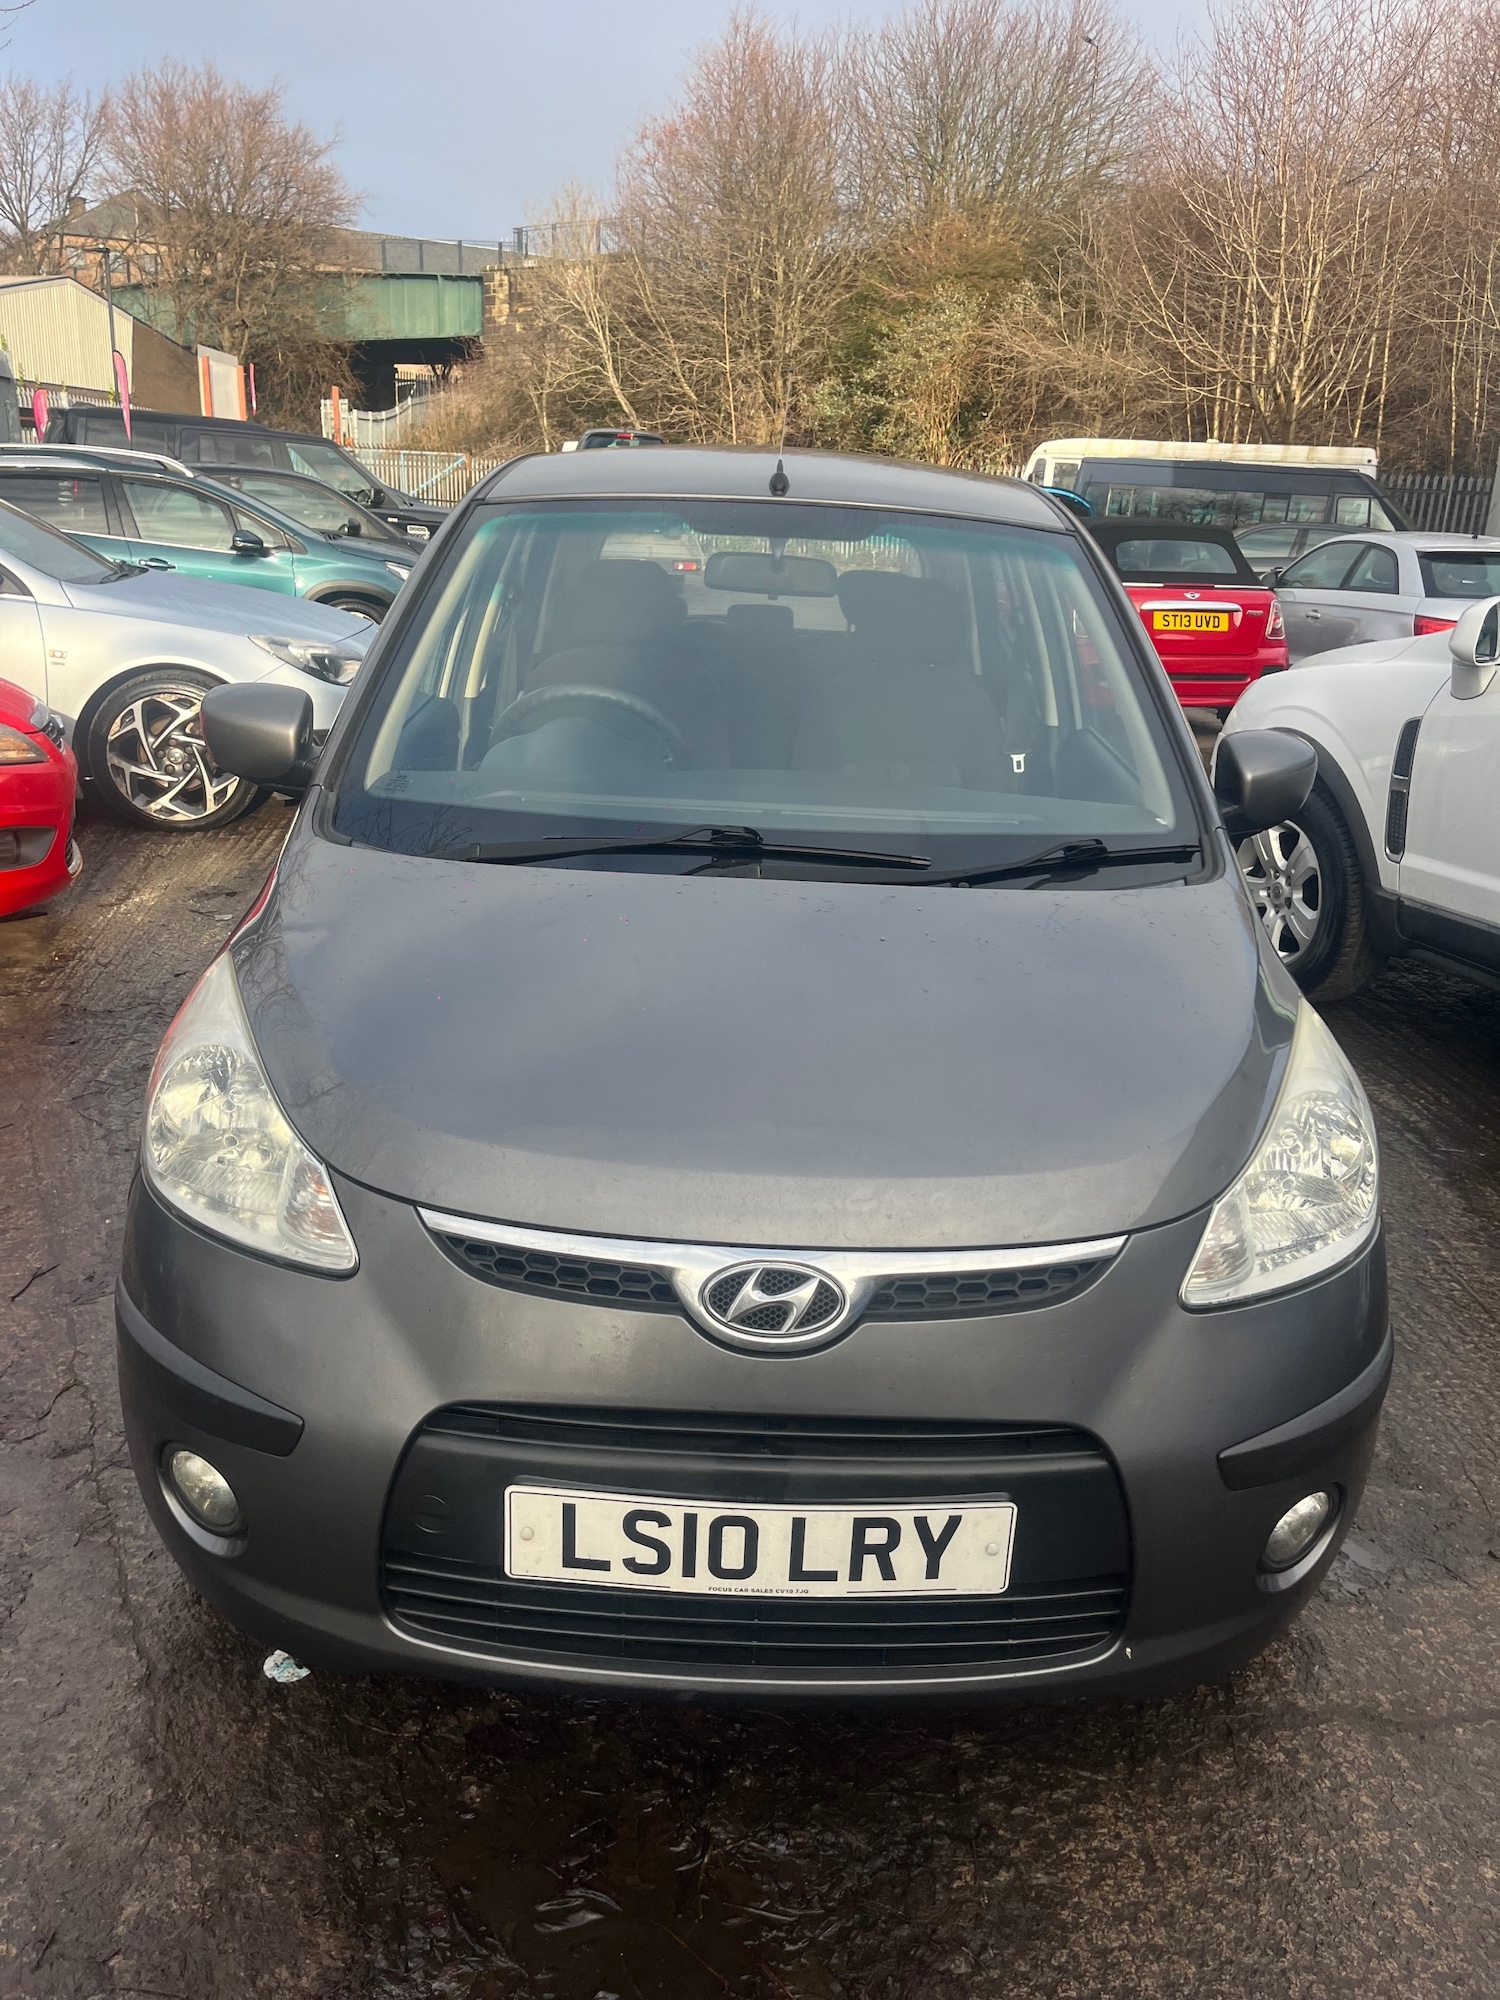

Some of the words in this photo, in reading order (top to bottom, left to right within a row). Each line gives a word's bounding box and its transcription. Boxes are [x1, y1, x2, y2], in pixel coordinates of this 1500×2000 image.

[1162, 614, 1191, 628] ST13
[1195, 615, 1220, 629] UVD
[562, 1502, 760, 1581] LS10
[788, 1514, 963, 1582] LRY
